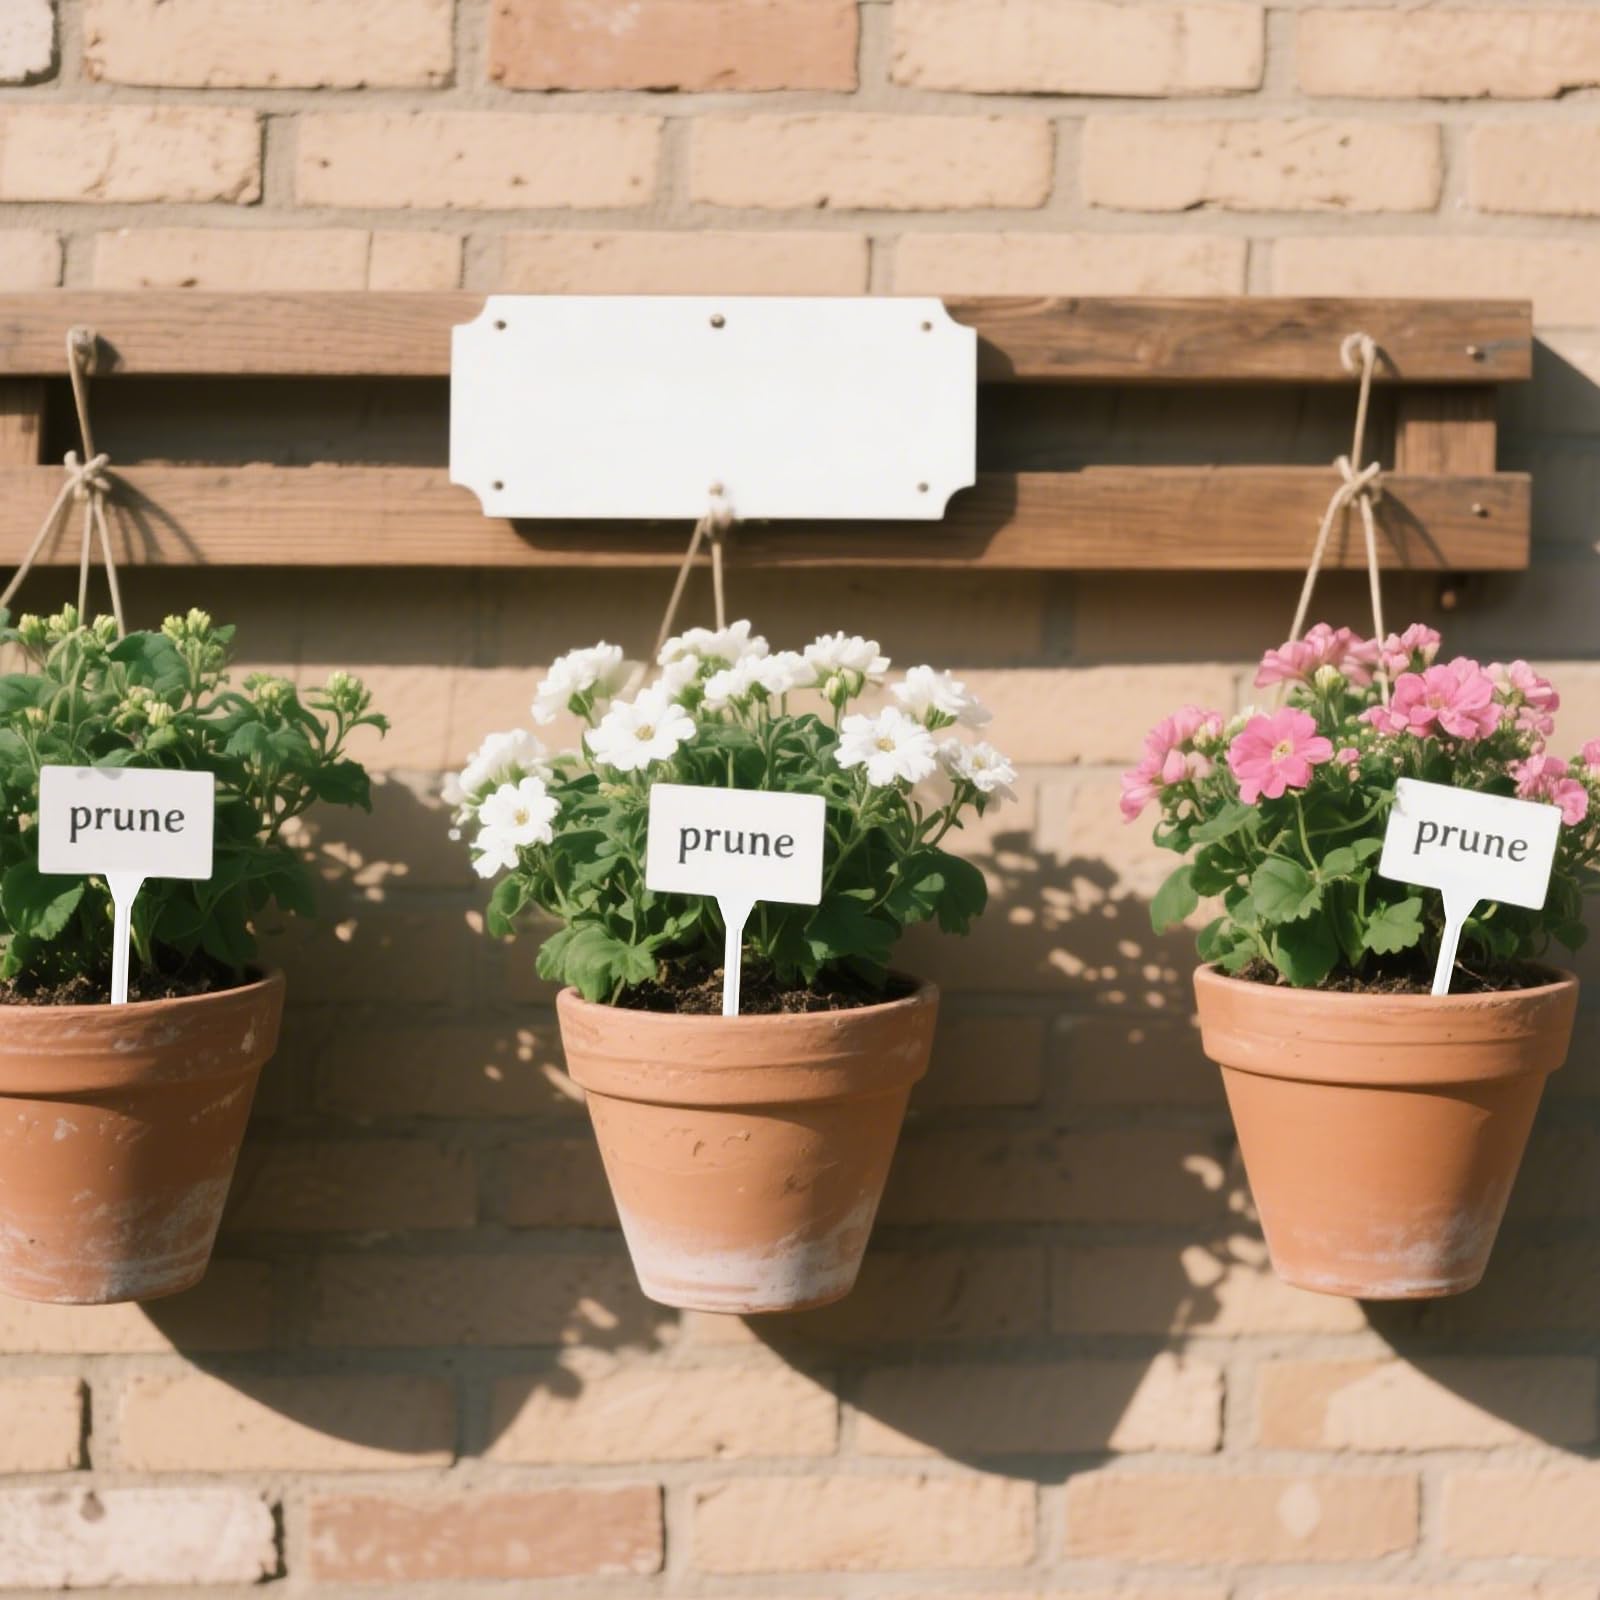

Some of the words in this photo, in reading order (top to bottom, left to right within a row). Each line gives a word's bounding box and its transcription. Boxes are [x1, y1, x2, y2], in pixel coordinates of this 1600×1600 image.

[70, 807, 185, 843] prune
[1414, 821, 1528, 862] prune
[679, 828, 794, 864] prune
